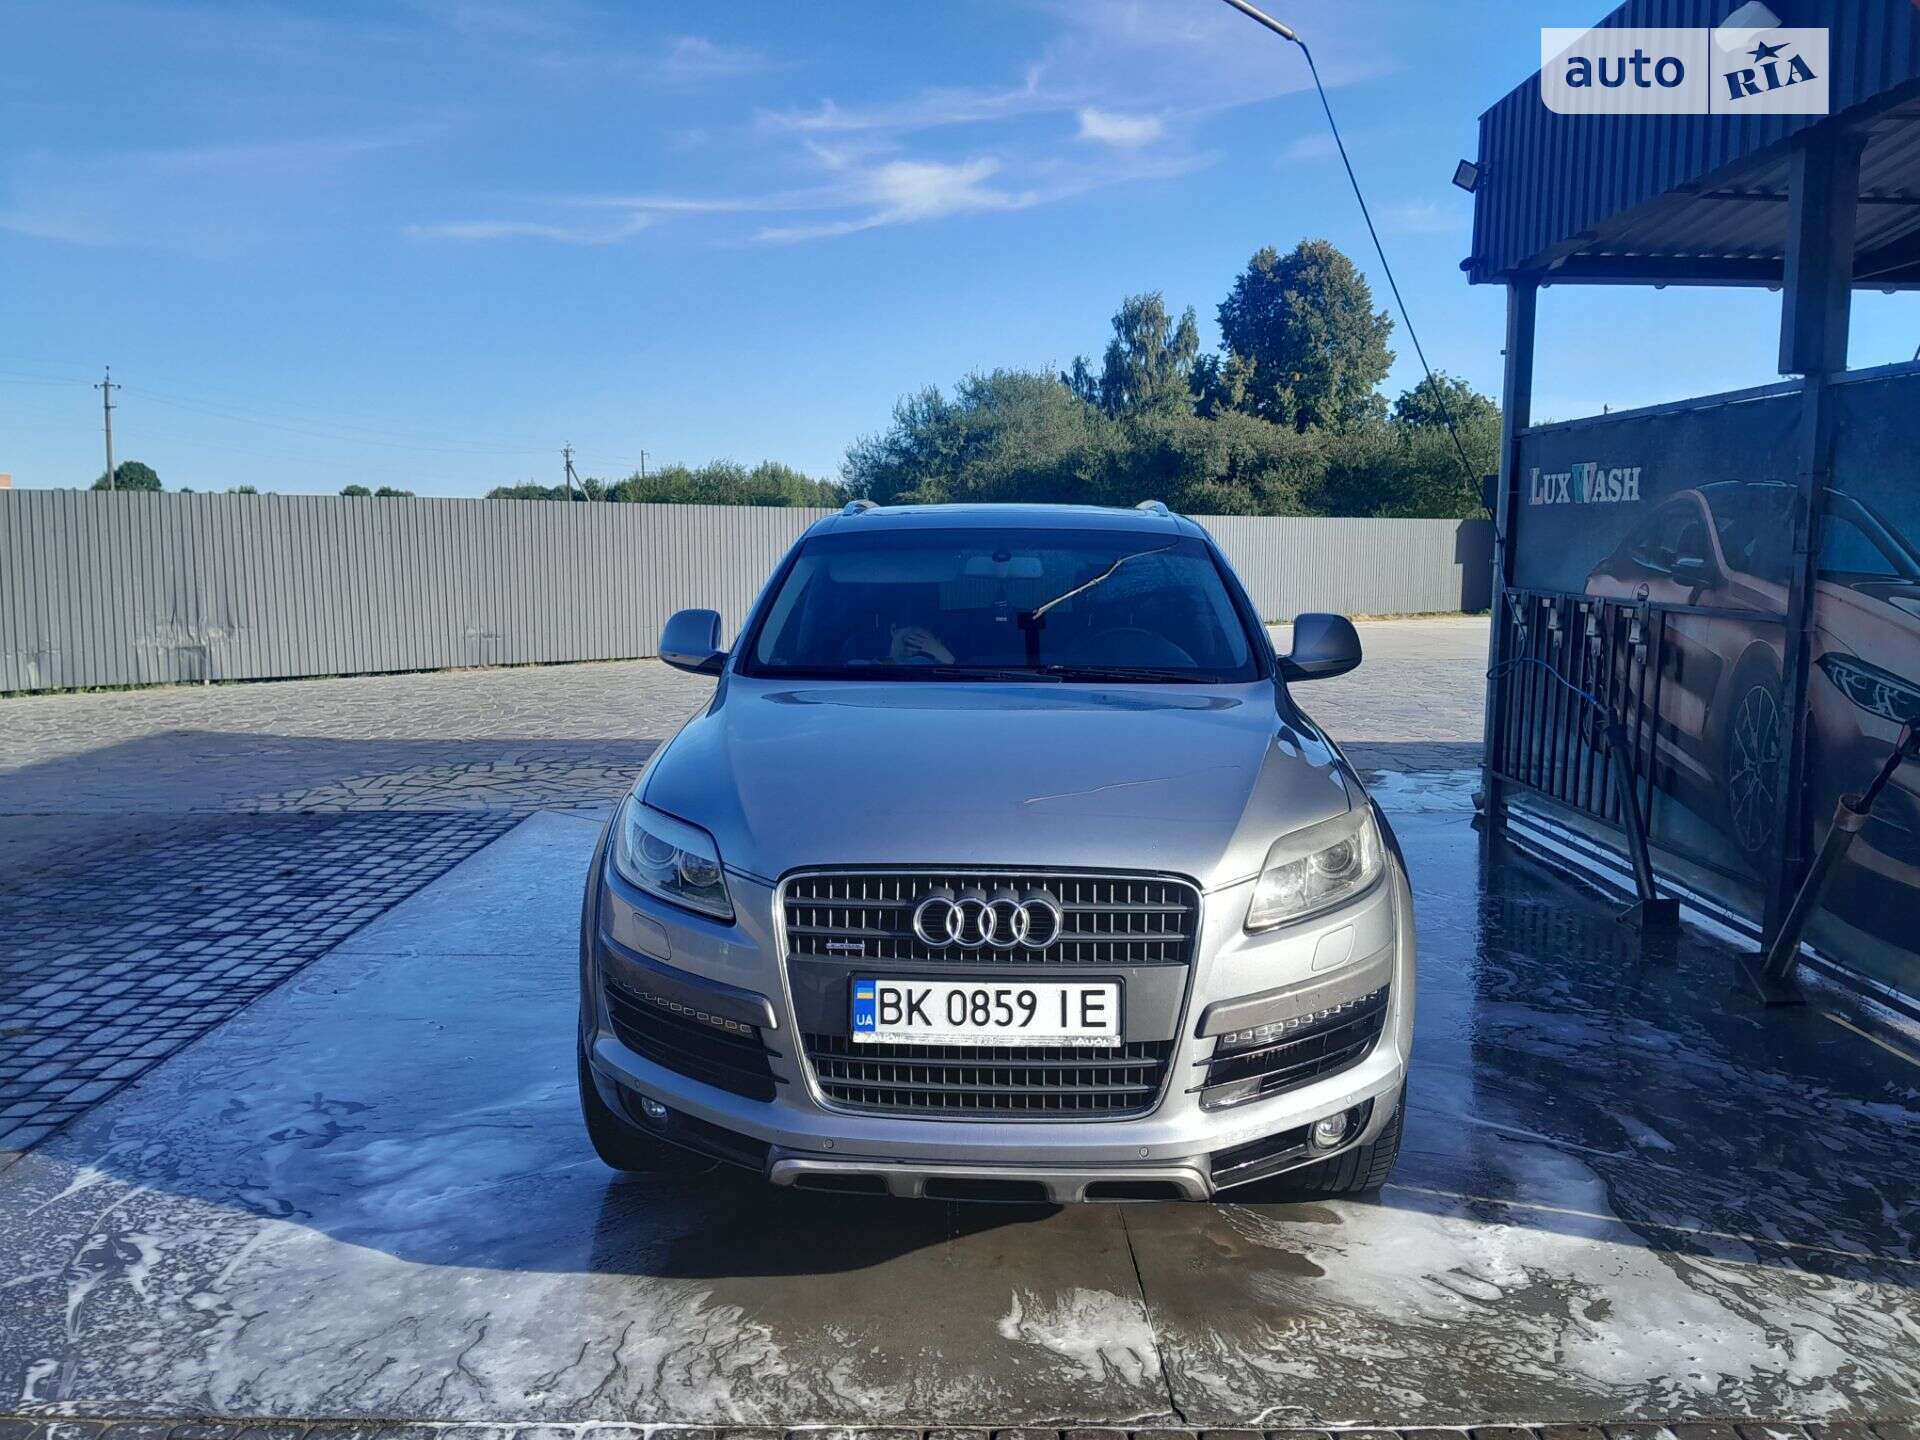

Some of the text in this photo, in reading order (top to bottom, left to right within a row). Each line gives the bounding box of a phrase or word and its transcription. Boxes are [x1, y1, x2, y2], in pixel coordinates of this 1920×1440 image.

[856, 1014, 874, 1026] UA
[879, 988, 1107, 1028] BK 0859 IE
